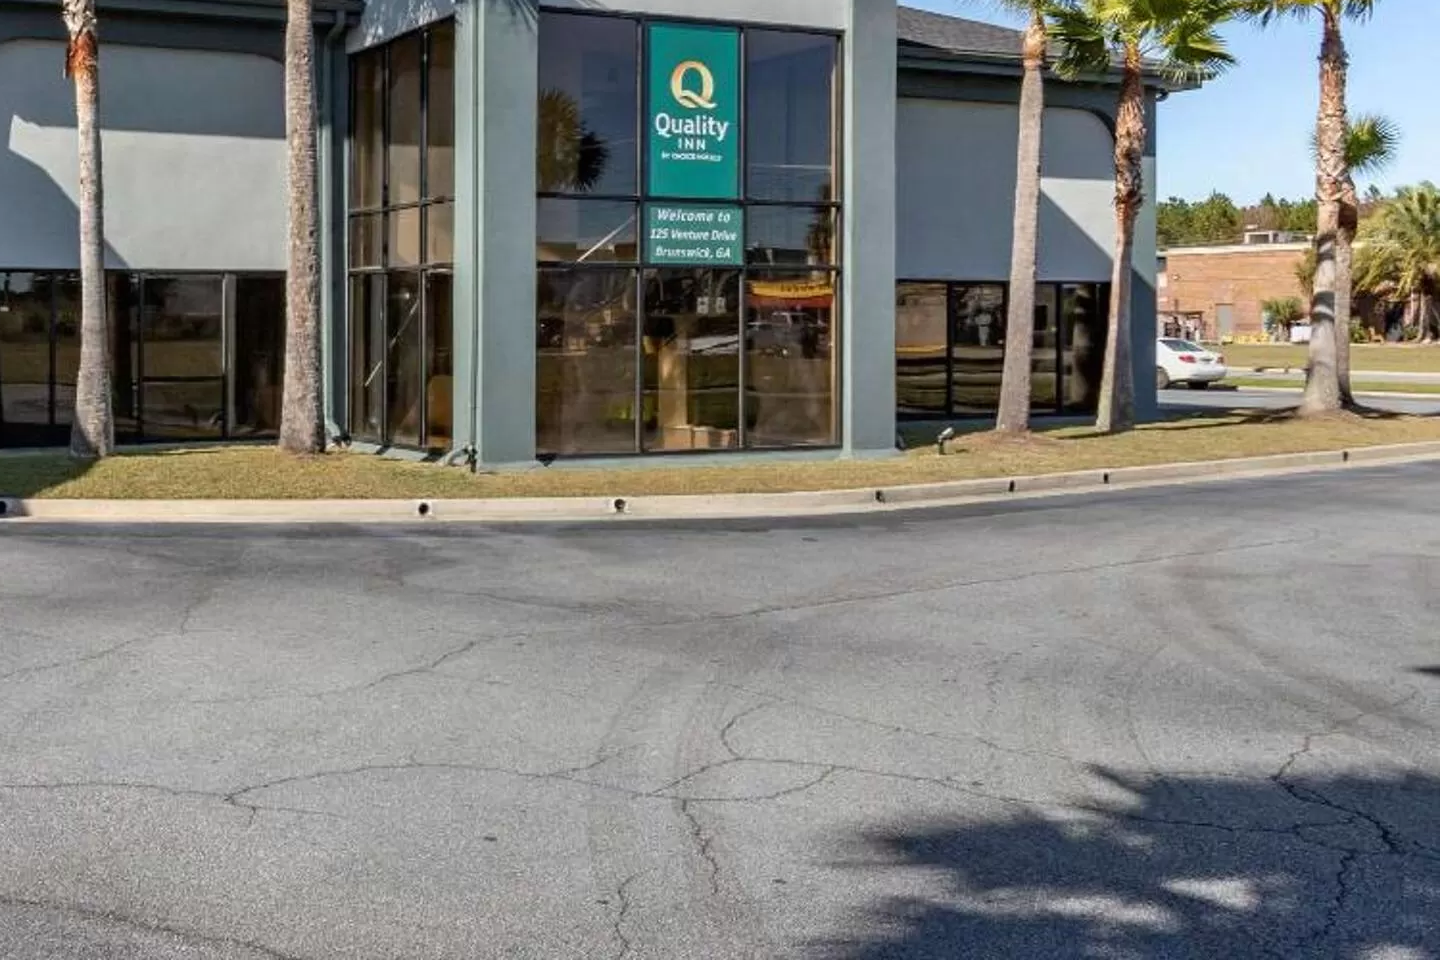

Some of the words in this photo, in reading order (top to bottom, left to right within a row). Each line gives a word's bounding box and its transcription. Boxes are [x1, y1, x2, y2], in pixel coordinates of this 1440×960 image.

[671, 61, 717, 109] Q
[655, 113, 729, 141] Quality
[678, 138, 706, 150] INN
[657, 208, 714, 221] Welcome
[718, 211, 731, 223] to
[650, 227, 668, 239] 125
[671, 229, 710, 240] Venture
[711, 230, 737, 241] Drive
[715, 247, 731, 258] GA
